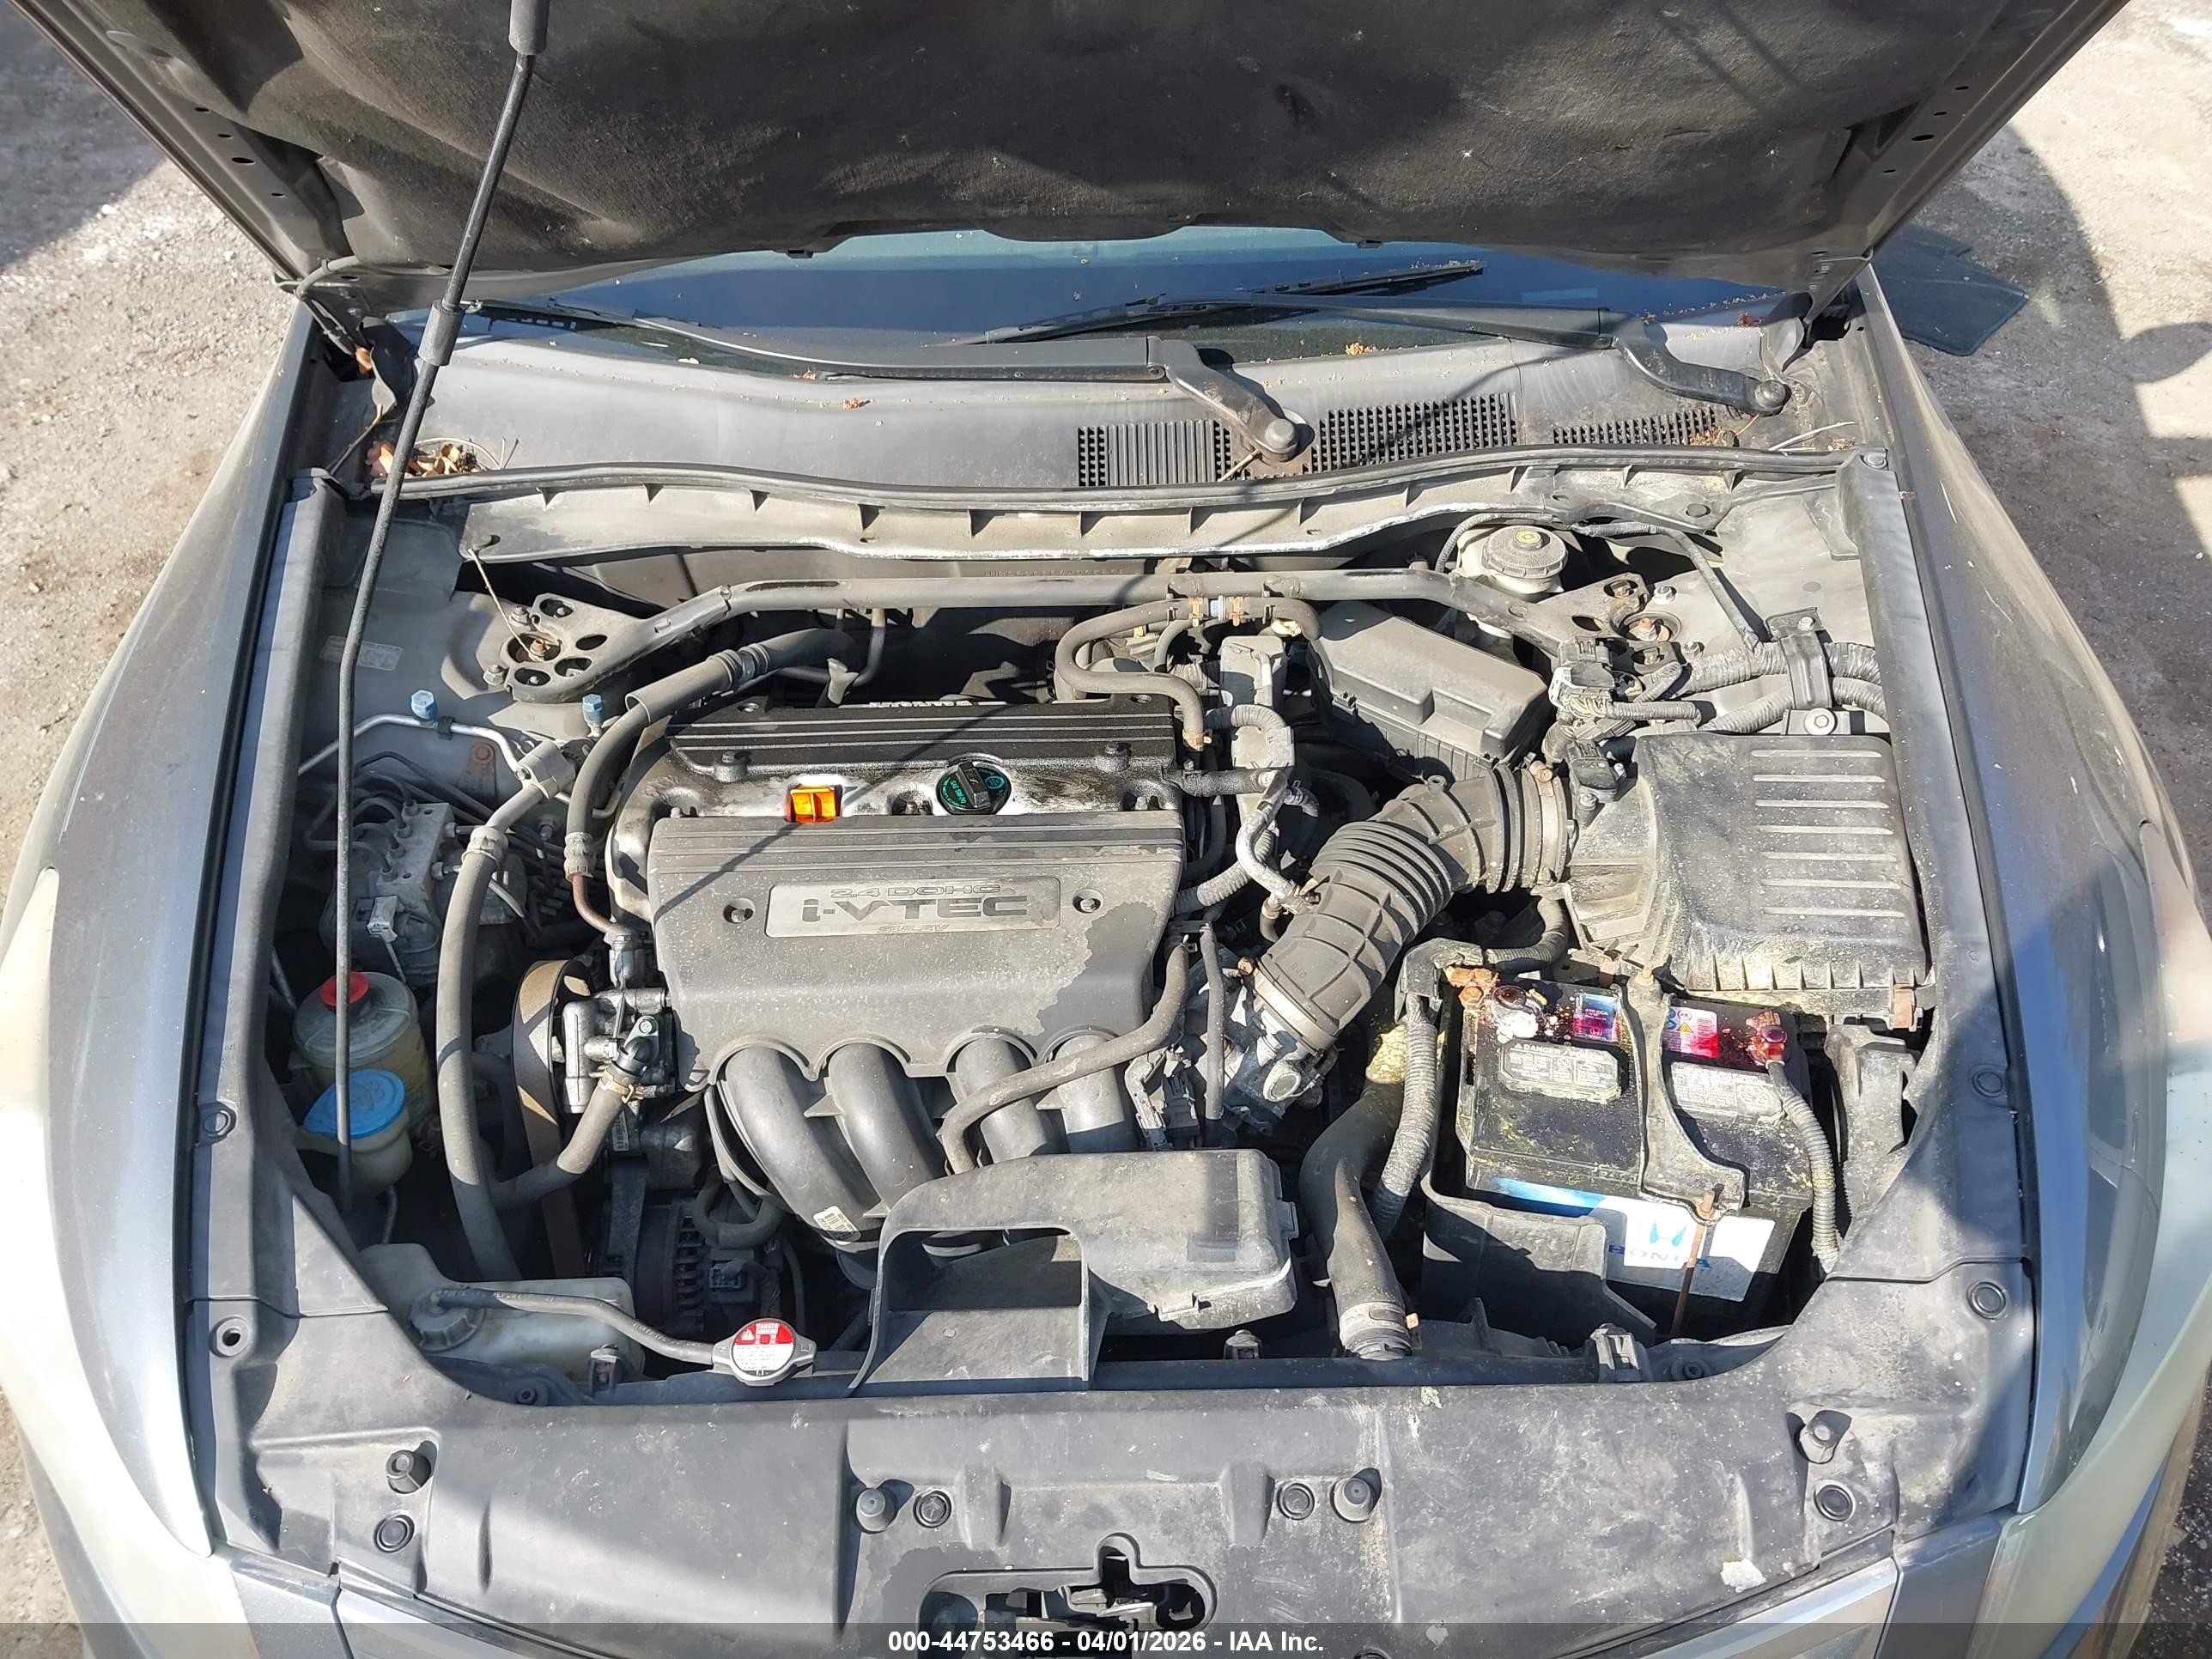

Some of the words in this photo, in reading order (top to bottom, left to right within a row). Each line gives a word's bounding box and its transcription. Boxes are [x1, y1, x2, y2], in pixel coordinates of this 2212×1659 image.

[830, 887, 881, 898] 2.4
[887, 884, 1001, 896] DOHC
[801, 895, 1028, 922] i-VTEC
